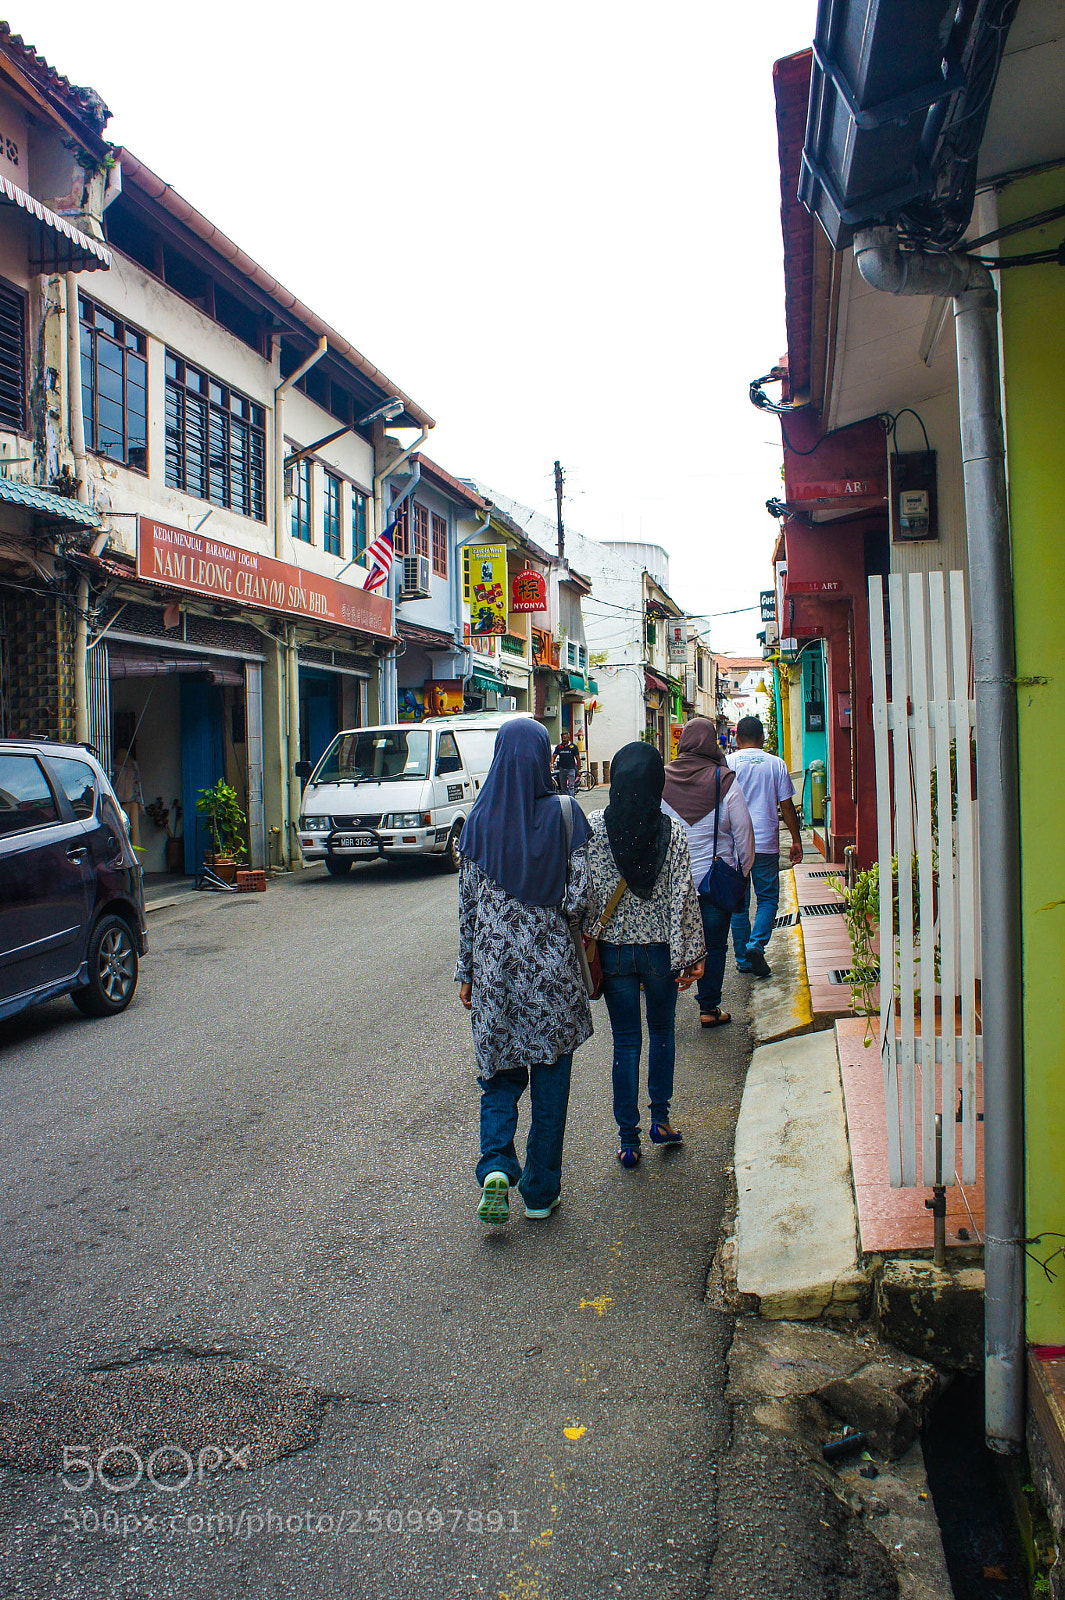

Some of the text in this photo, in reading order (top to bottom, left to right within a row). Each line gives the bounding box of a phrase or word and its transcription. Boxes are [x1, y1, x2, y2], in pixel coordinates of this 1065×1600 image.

[844, 481, 870, 494] ART
[153, 525, 174, 543] KEDAI
[174, 532, 203, 552] MENJUAL
[206, 542, 237, 562] BARANGAN
[153, 546, 187, 580] NAM
[189, 557, 232, 592] LEONG
[235, 570, 269, 600] CHAN
[269, 579, 285, 608] (M)
[518, 578, 540, 601] 粽
[821, 582, 838, 590] ART
[761, 595, 775, 605] Gues
[513, 602, 545, 610] NYONYA
[762, 608, 775, 619] Hous
[355, 837, 372, 846] 3752
